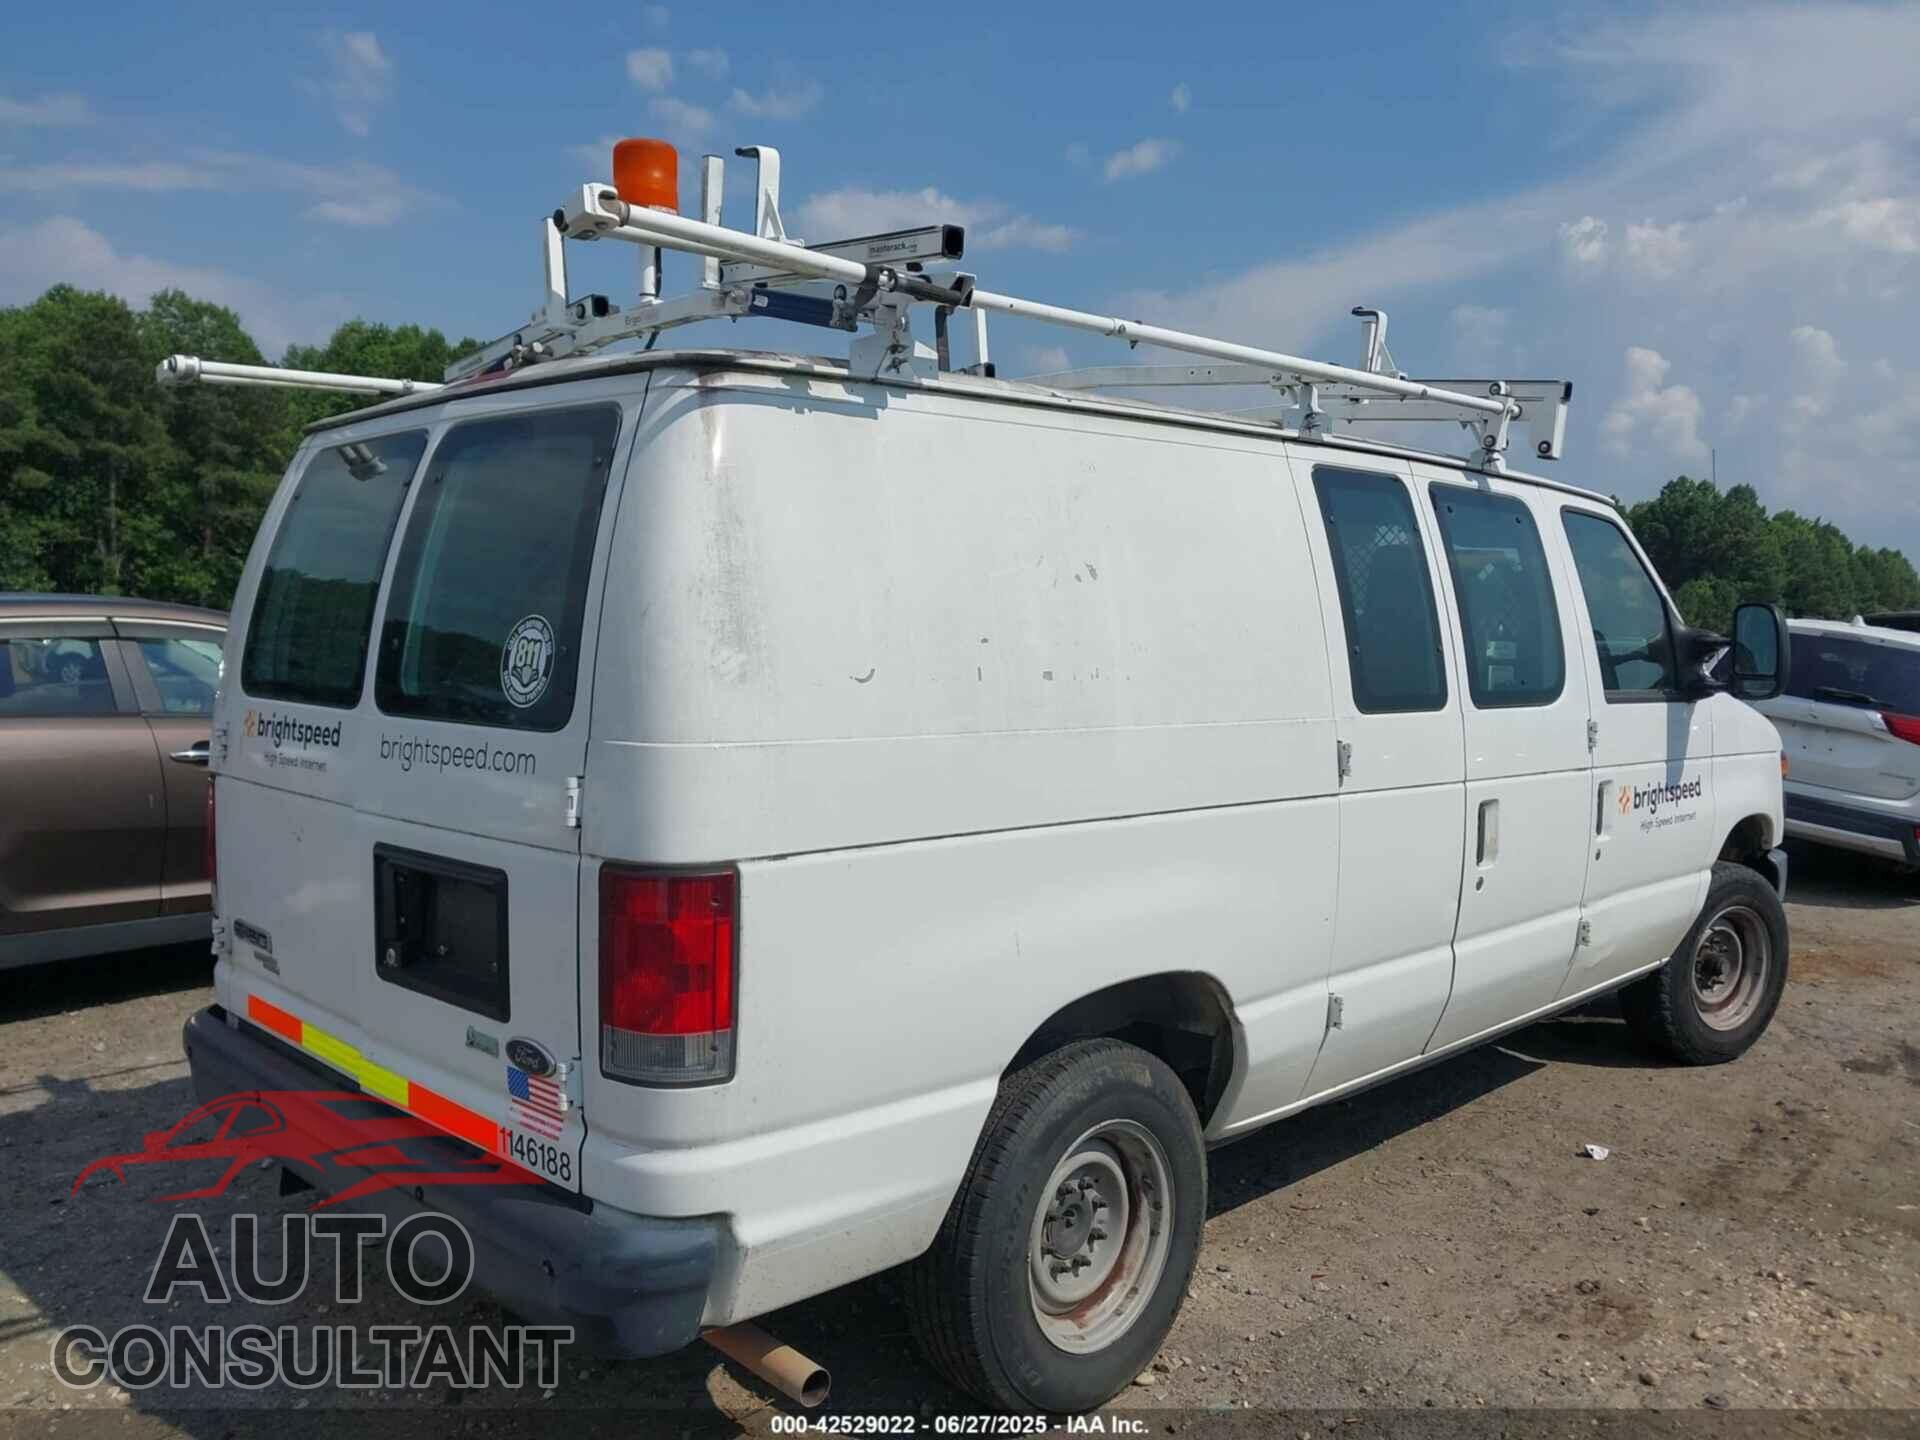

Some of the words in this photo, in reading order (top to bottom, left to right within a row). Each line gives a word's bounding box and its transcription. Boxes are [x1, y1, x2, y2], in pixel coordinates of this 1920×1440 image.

[515, 636, 542, 670] 811
[257, 711, 342, 750] brightspeed
[380, 733, 537, 775] brightspeed.com
[1633, 774, 1702, 815] brightspeed
[500, 1127, 572, 1183] 1146188
